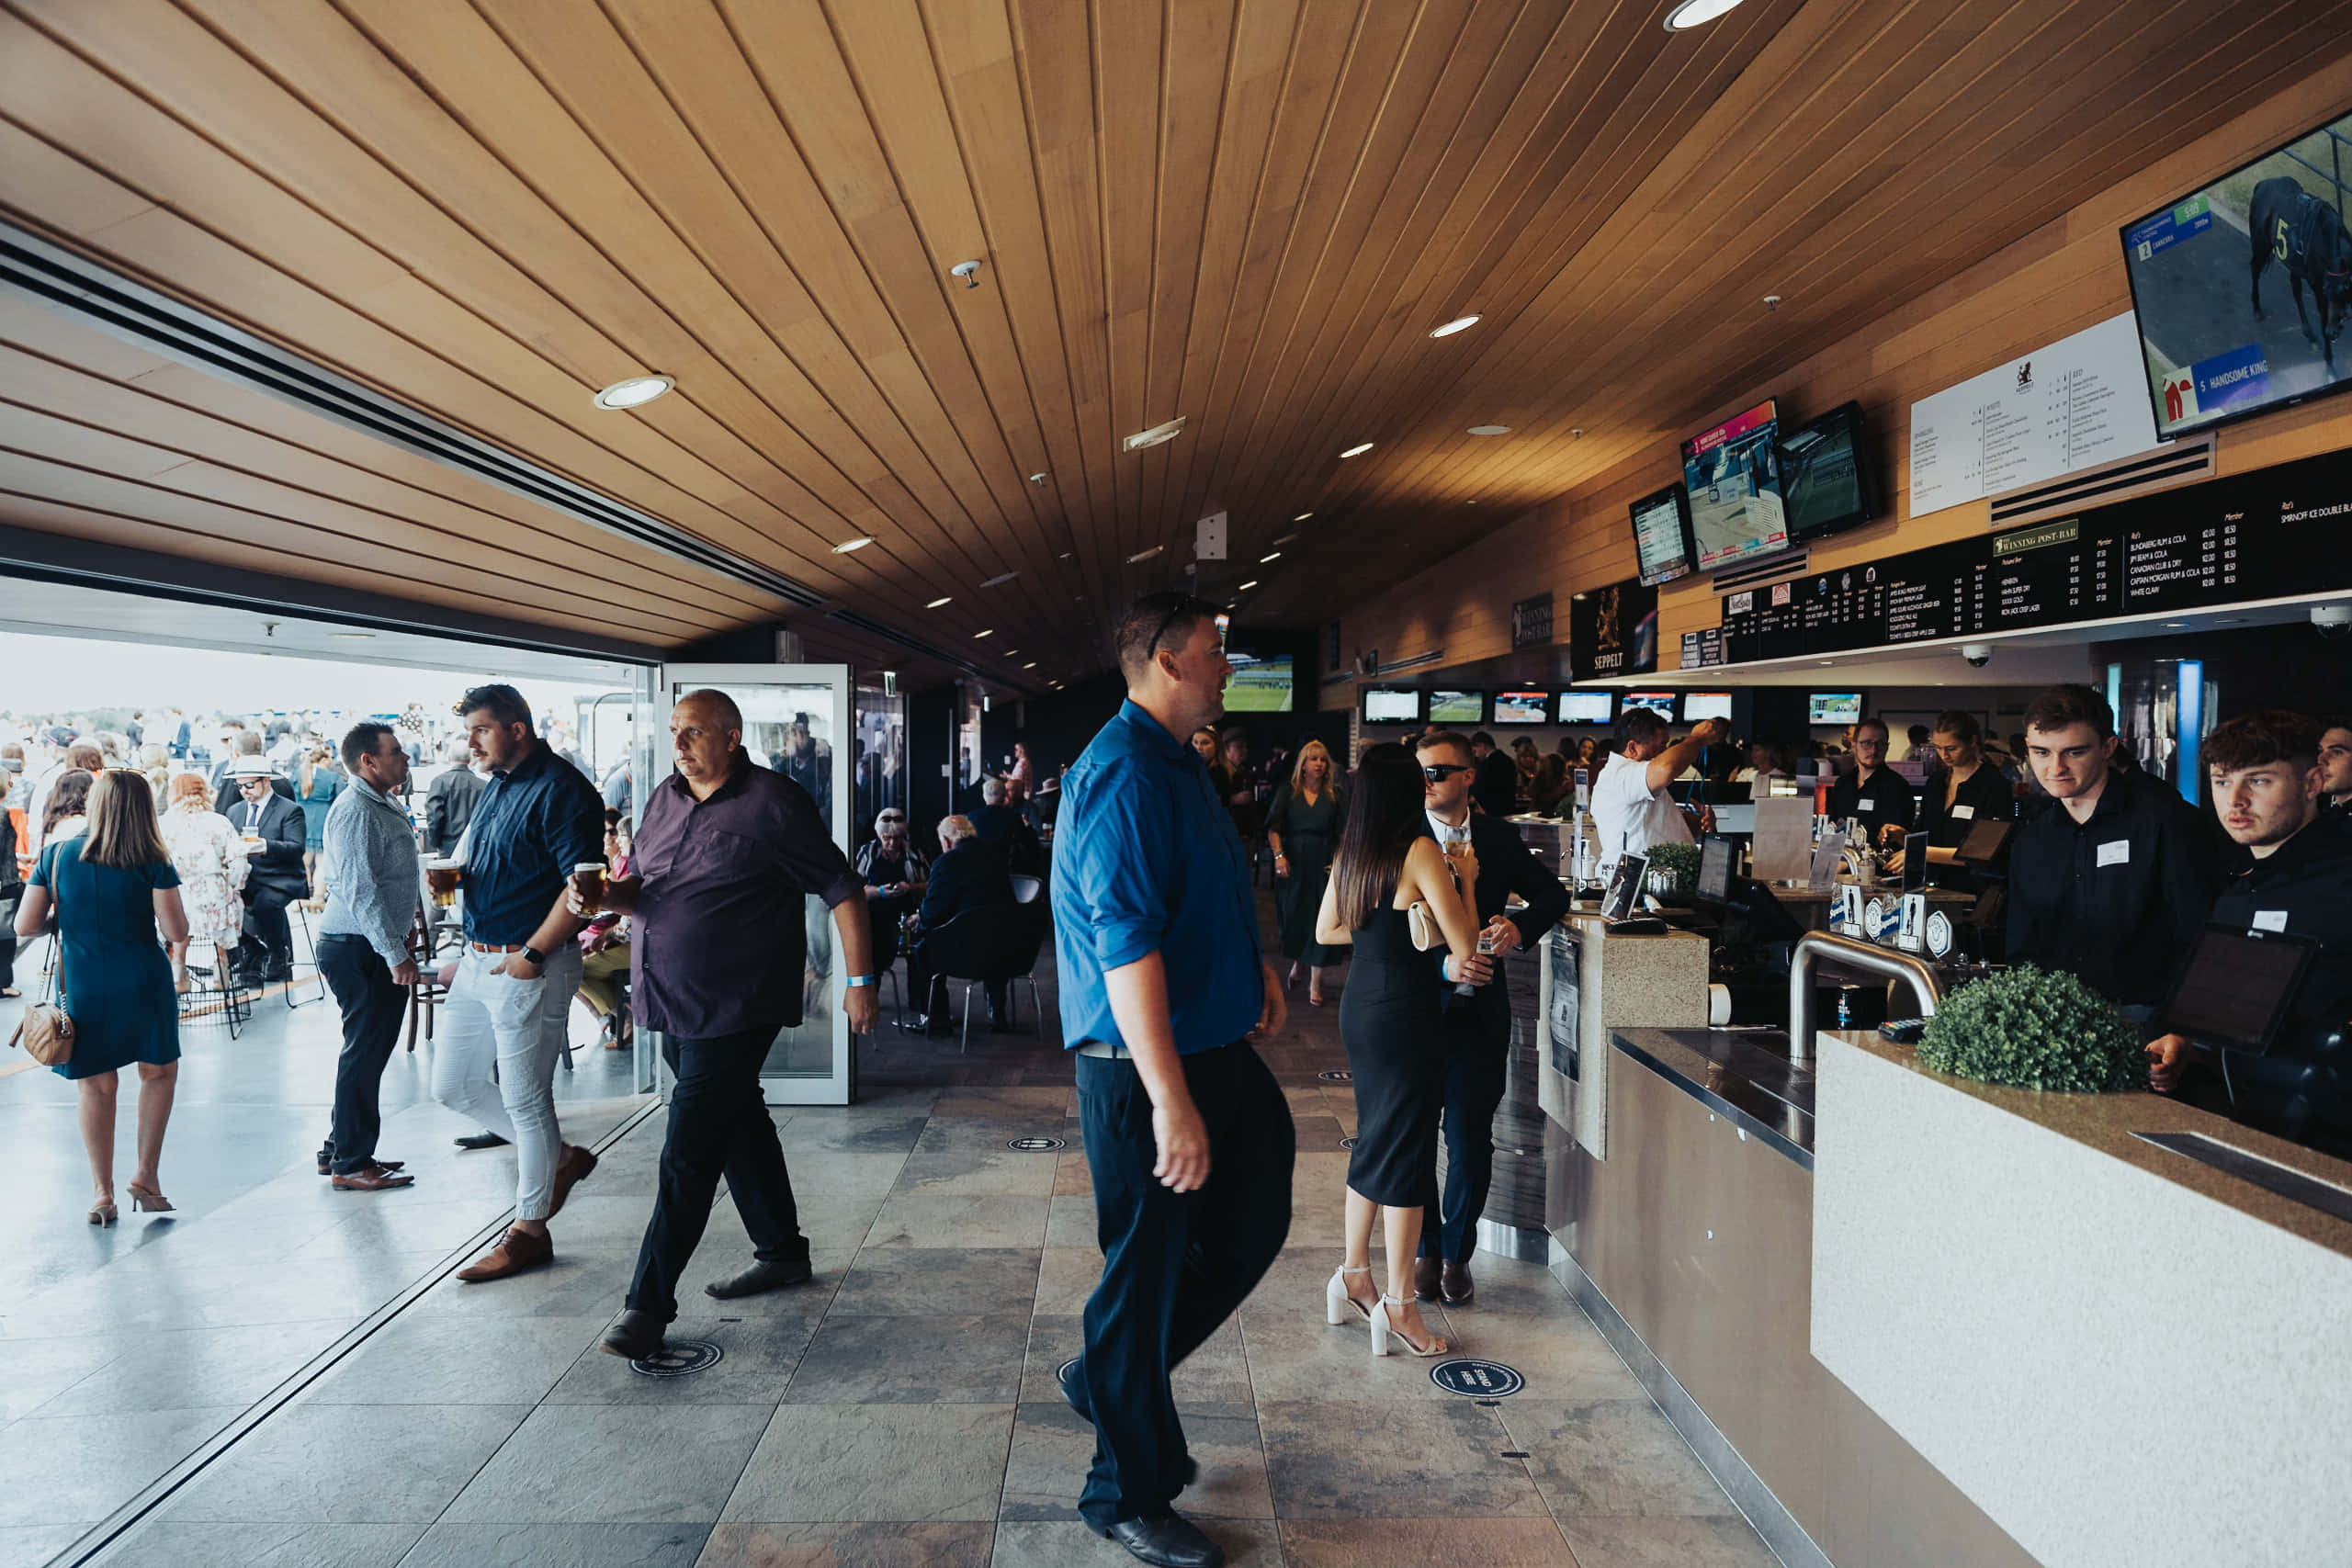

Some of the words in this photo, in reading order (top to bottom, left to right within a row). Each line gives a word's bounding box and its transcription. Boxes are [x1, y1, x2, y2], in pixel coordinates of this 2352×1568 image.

[2275, 218, 2289, 261] 5
[2200, 381, 2206, 392] 5
[2210, 366, 2250, 389] HANDSOME
[2250, 360, 2269, 376] KING
[2309, 509, 2318, 518] ICE
[2318, 504, 2342, 517] DOUBLE
[2003, 536, 2035, 552] WINNING
[2038, 532, 2057, 545] POST
[2059, 528, 2076, 538] BAR
[1595, 652, 1623, 670] SEPPELT
[1474, 1369, 1492, 1387] STAND
